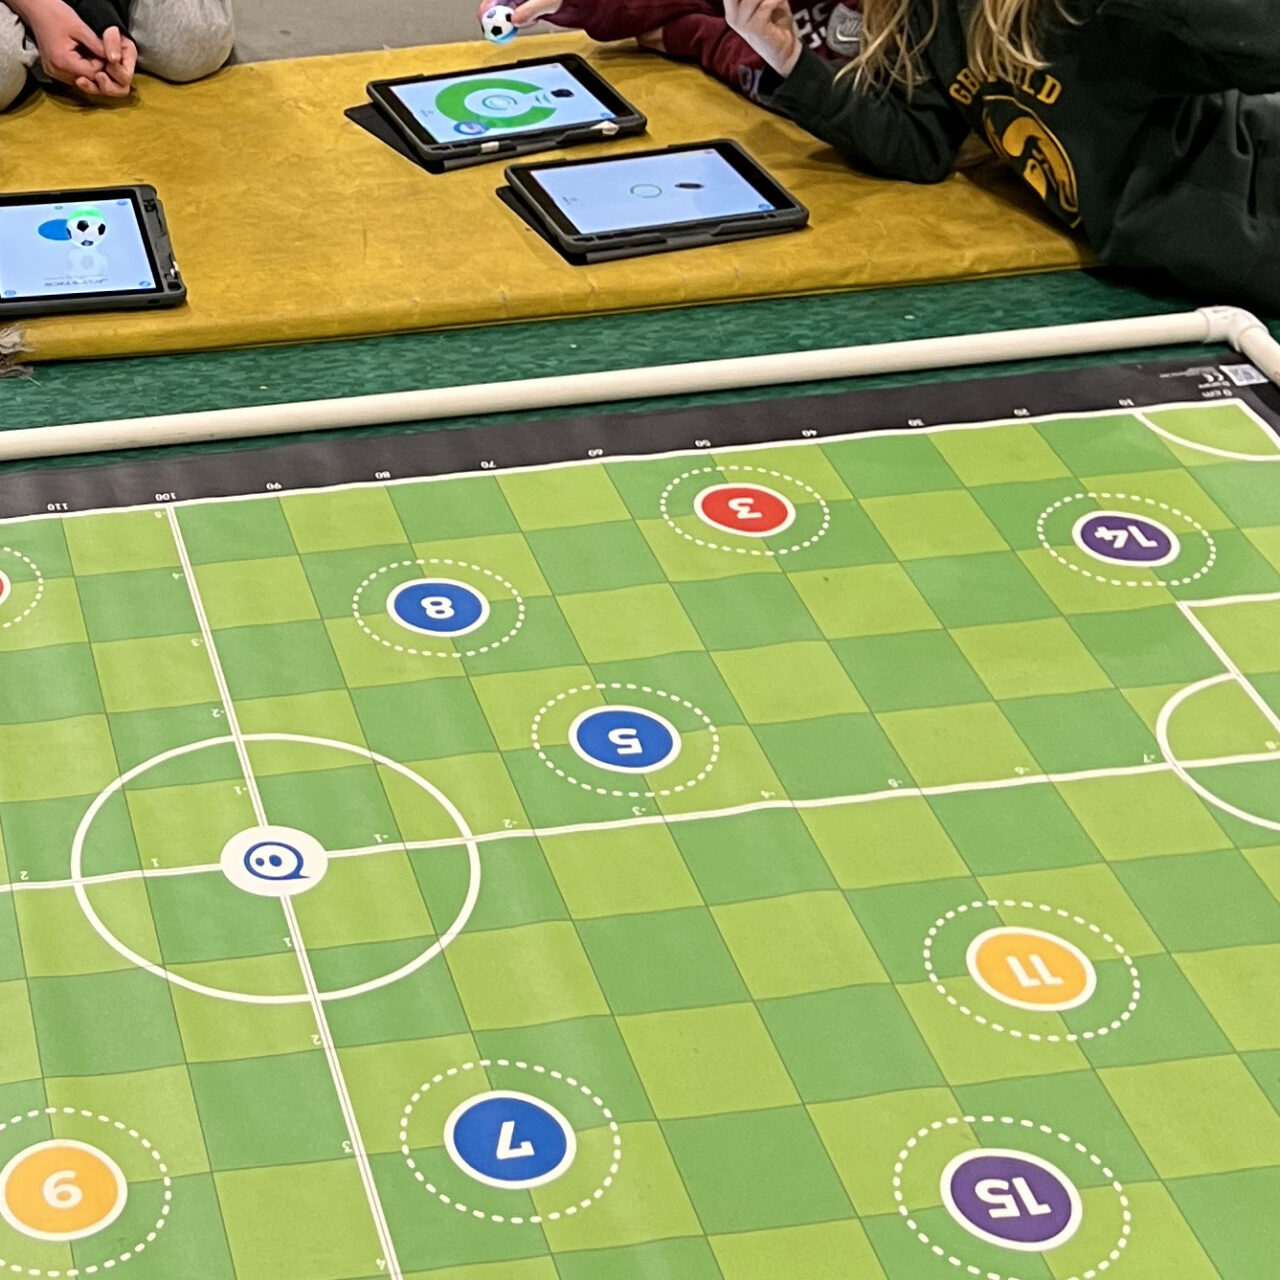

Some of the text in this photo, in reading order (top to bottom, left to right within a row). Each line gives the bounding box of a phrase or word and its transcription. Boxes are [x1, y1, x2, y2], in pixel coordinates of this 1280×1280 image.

[480, 460, 496, 468] 70
[588, 449, 603, 457] 60
[266, 482, 282, 490] 90
[375, 471, 391, 479] 80
[47, 503, 68, 511] 110
[155, 492, 176, 501] 100
[728, 497, 762, 519] 3
[1094, 525, 1158, 548] 14
[421, 596, 455, 619] 8
[608, 728, 643, 755] 5
[1006, 954, 1064, 987] 11
[496, 1120, 535, 1160] 7
[975, 1177, 1052, 1218] 15
